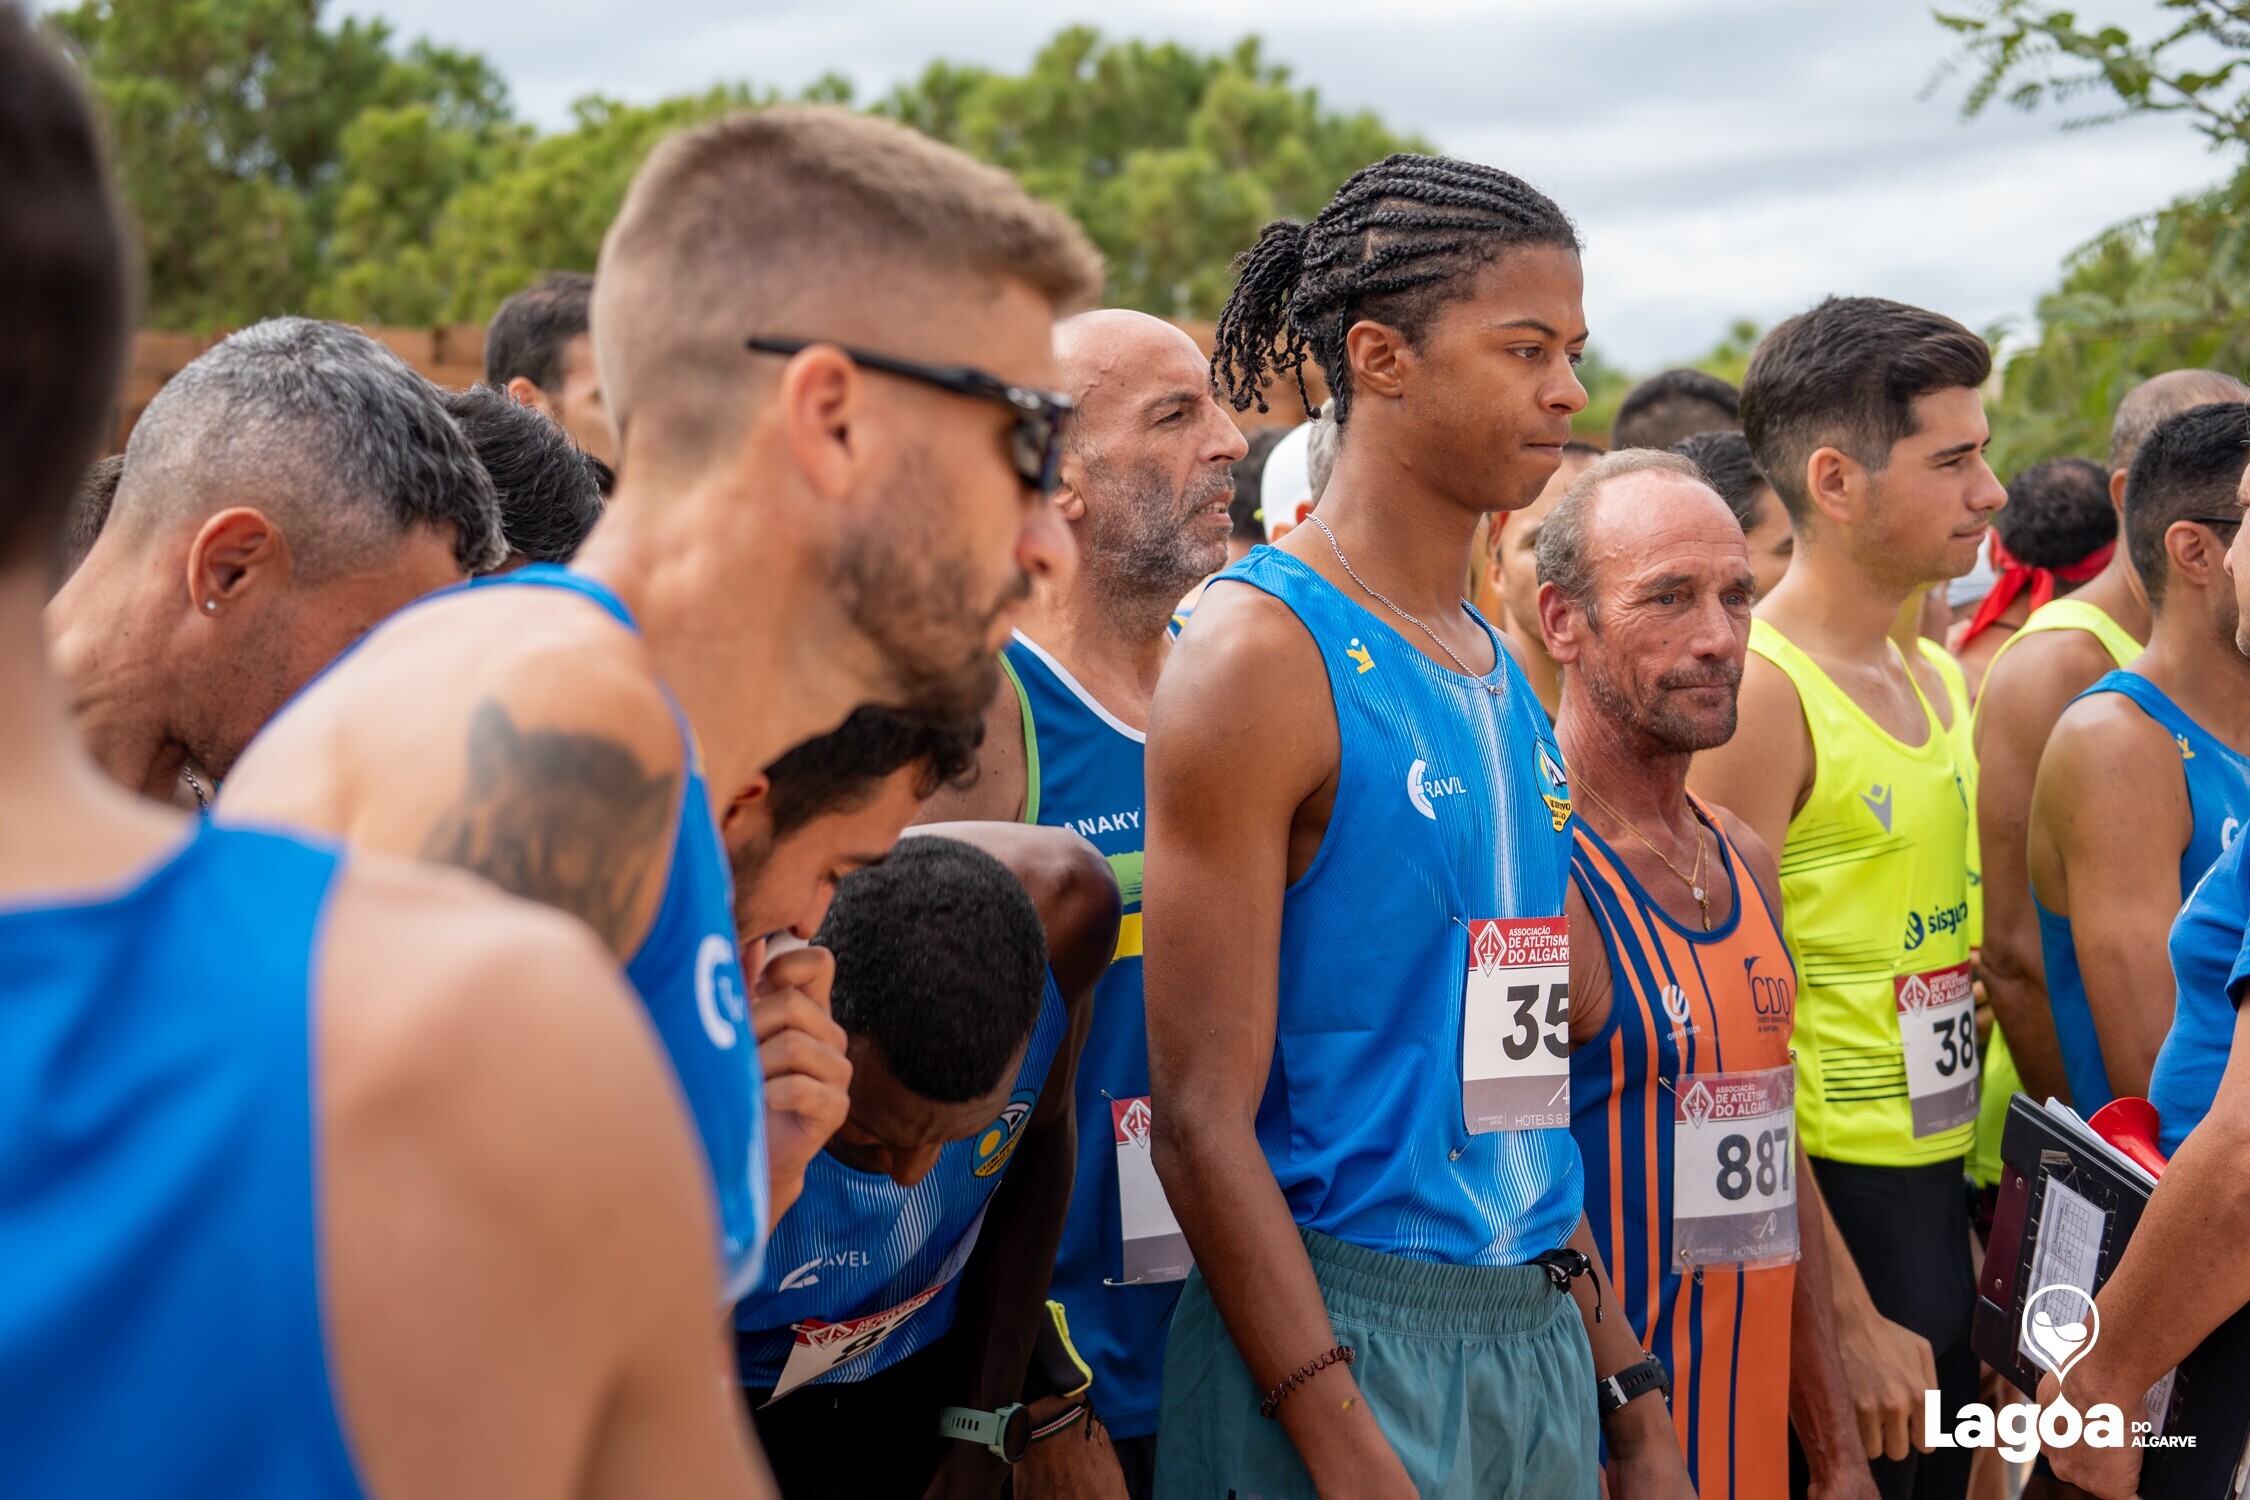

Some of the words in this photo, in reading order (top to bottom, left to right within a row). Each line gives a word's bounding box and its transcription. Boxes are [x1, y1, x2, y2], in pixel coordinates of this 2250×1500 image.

[1509, 925, 1551, 937] ASSOCIAÇÃO
[1509, 937, 1521, 949] DE
[1508, 949, 1526, 964] DO
[1528, 946, 1570, 963] ALGAR
[1502, 983, 1570, 1061] 35
[1932, 1010, 1974, 1077] 38
[1715, 1094, 1729, 1105] DE
[1715, 1104, 1734, 1118] DO
[1515, 1113, 1554, 1127] HOTELS
[1556, 1113, 1564, 1125] &
[1716, 1126, 1789, 1201] 887
[1733, 1244, 1764, 1257] HOTELS
